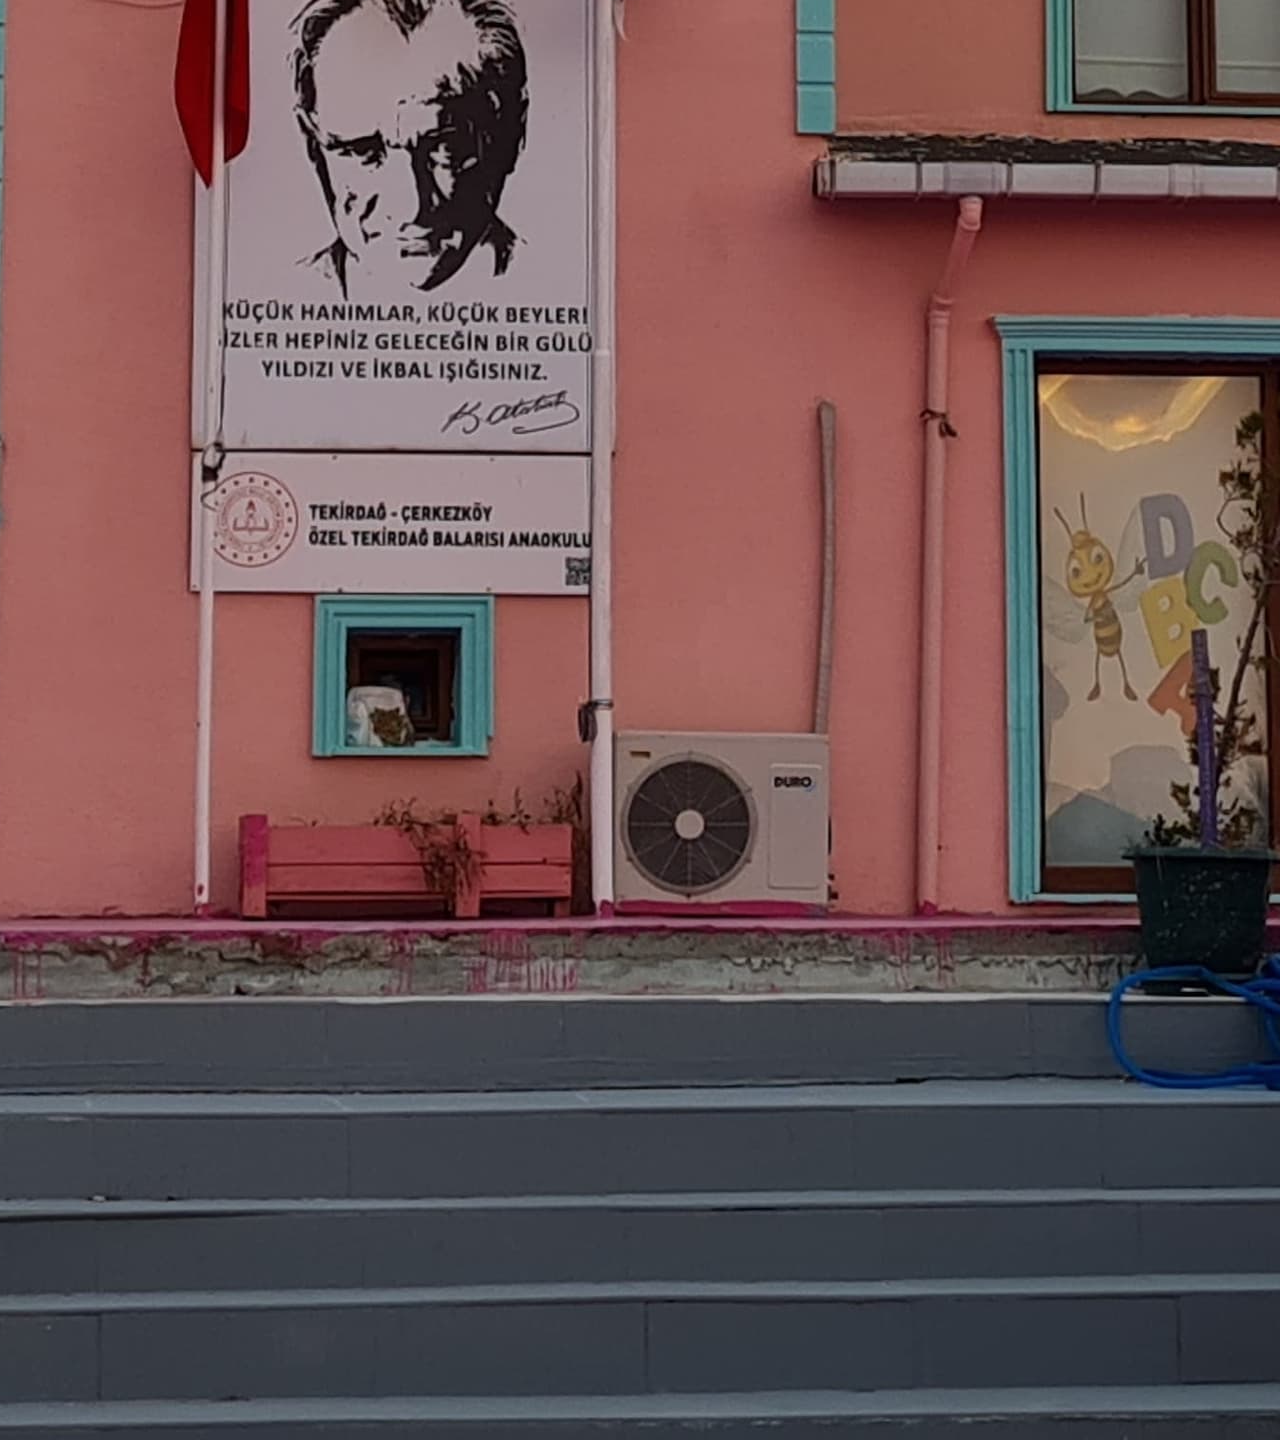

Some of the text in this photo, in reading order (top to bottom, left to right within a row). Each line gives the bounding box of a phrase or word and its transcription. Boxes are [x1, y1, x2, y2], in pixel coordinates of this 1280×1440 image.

[223, 299, 294, 324] KÜÇÜK
[301, 304, 421, 325] HANIMLAR,
[427, 302, 499, 326] KÜÇÜK
[218, 329, 279, 349] İZLER
[285, 329, 368, 350] HEPİNİZ
[375, 330, 489, 351] GELECEĞİN
[495, 331, 529, 352] BİR
[262, 358, 548, 383] YILDIZI VE İKBAL IŞIĞISINIZ.
[308, 501, 387, 521] TEKİRDAĞ
[401, 502, 493, 524] ÇERKEZKÖY
[308, 526, 592, 549] ÖZEL TEKİRDAĞ BALARISI ANAOKULU
[1140, 493, 1194, 580] D
[1185, 540, 1239, 625] C
[1140, 575, 1200, 669] B
[773, 775, 812, 789] DURO
